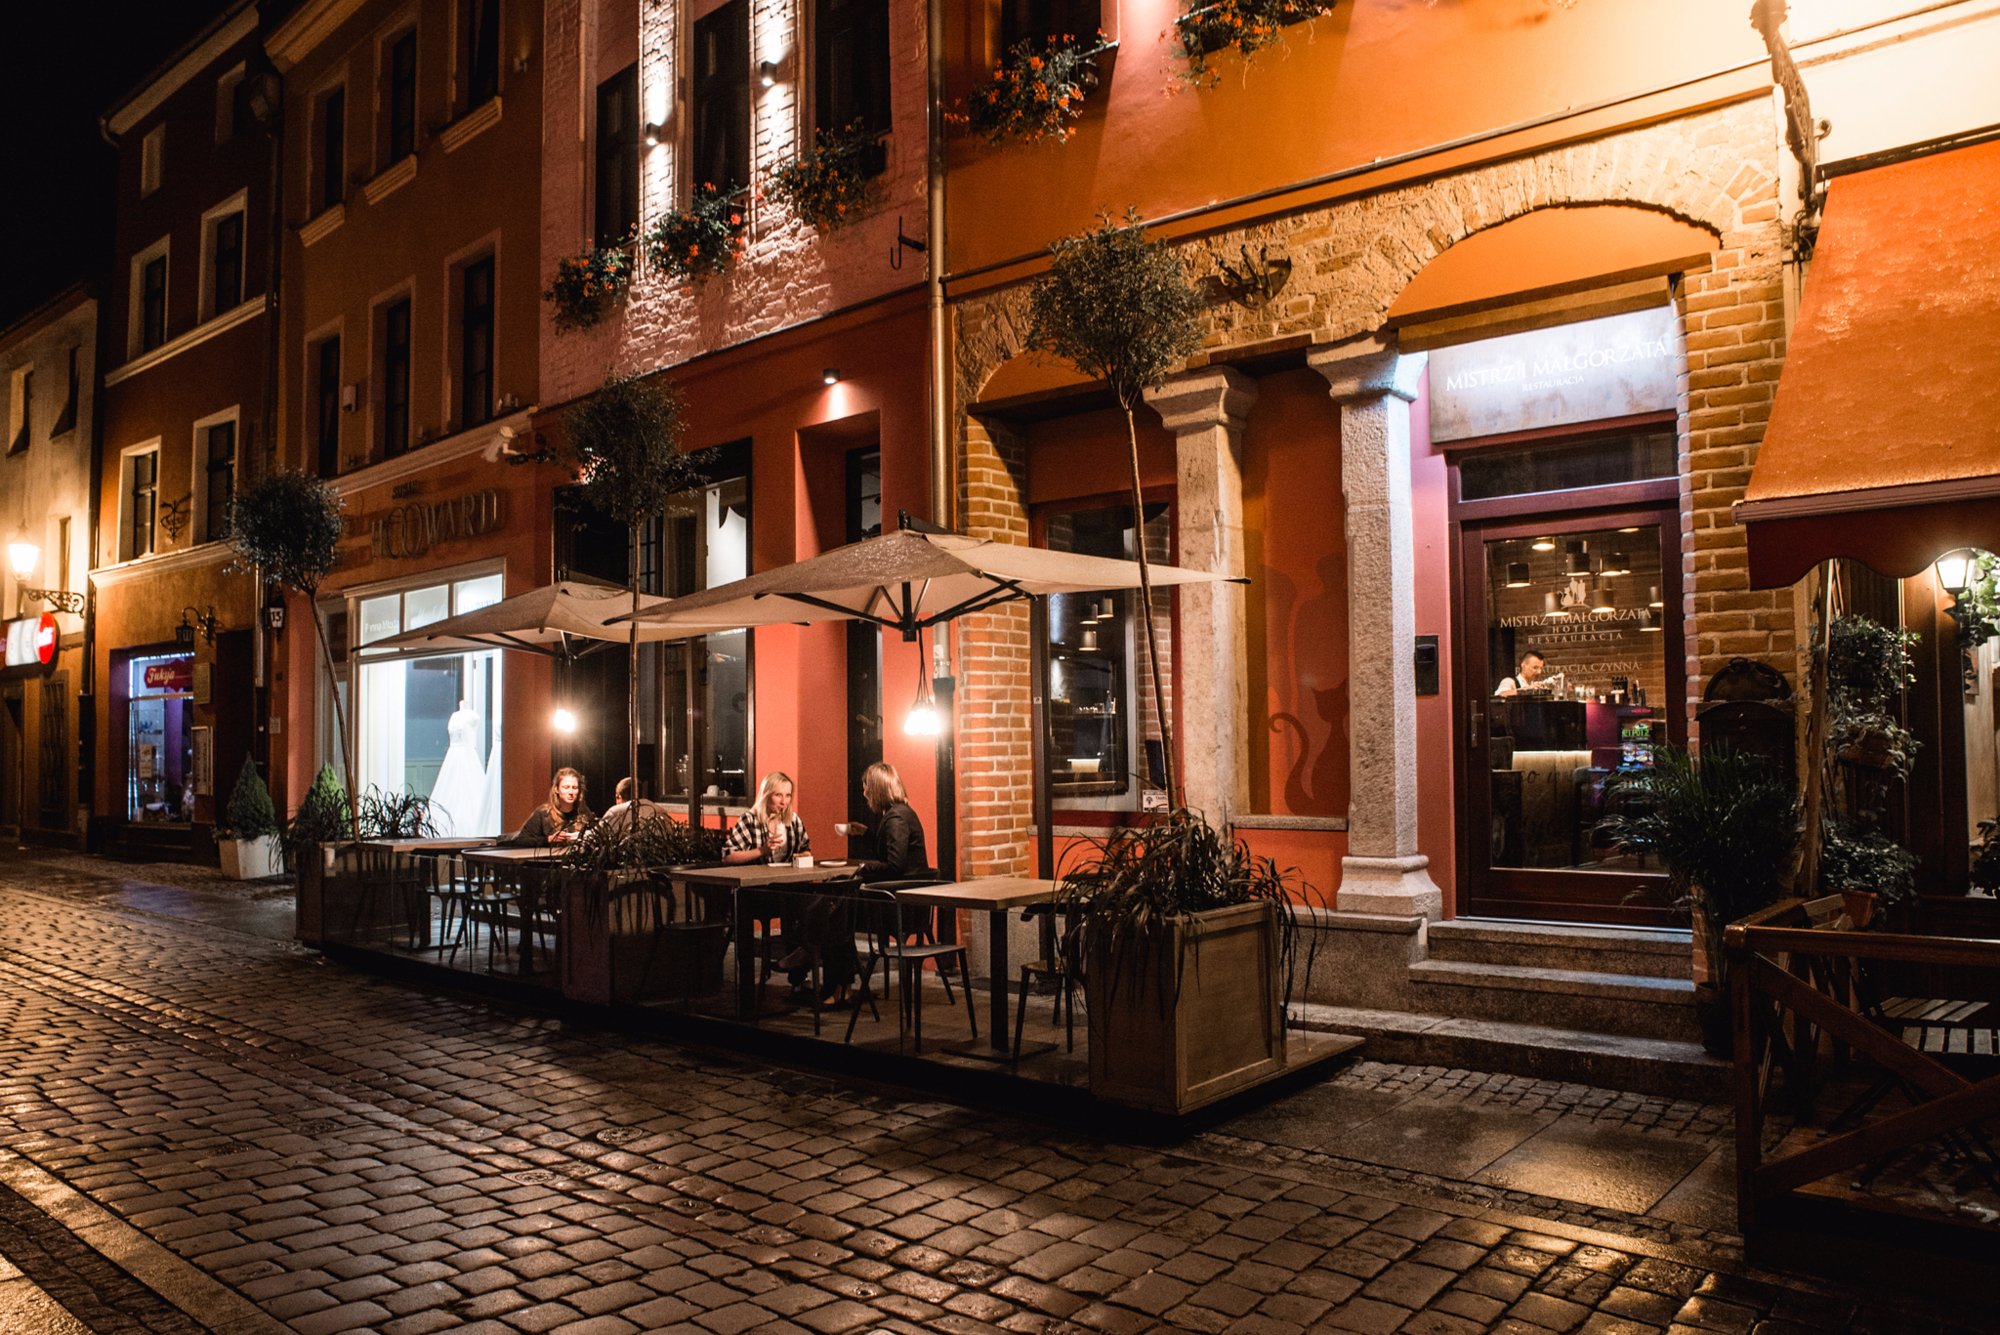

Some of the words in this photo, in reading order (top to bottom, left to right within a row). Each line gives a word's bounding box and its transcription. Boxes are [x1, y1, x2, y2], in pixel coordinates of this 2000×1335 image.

[1446, 364, 1516, 392] MISTRZ
[1521, 362, 1527, 377] I
[1522, 376, 1585, 392] RESTAURACJA
[1500, 614, 1549, 628] MISTRZ
[1560, 607, 1652, 624] MAŁGORZATA
[1552, 624, 1597, 634] HOTEL
[1528, 632, 1623, 645] RESTAURACJA
